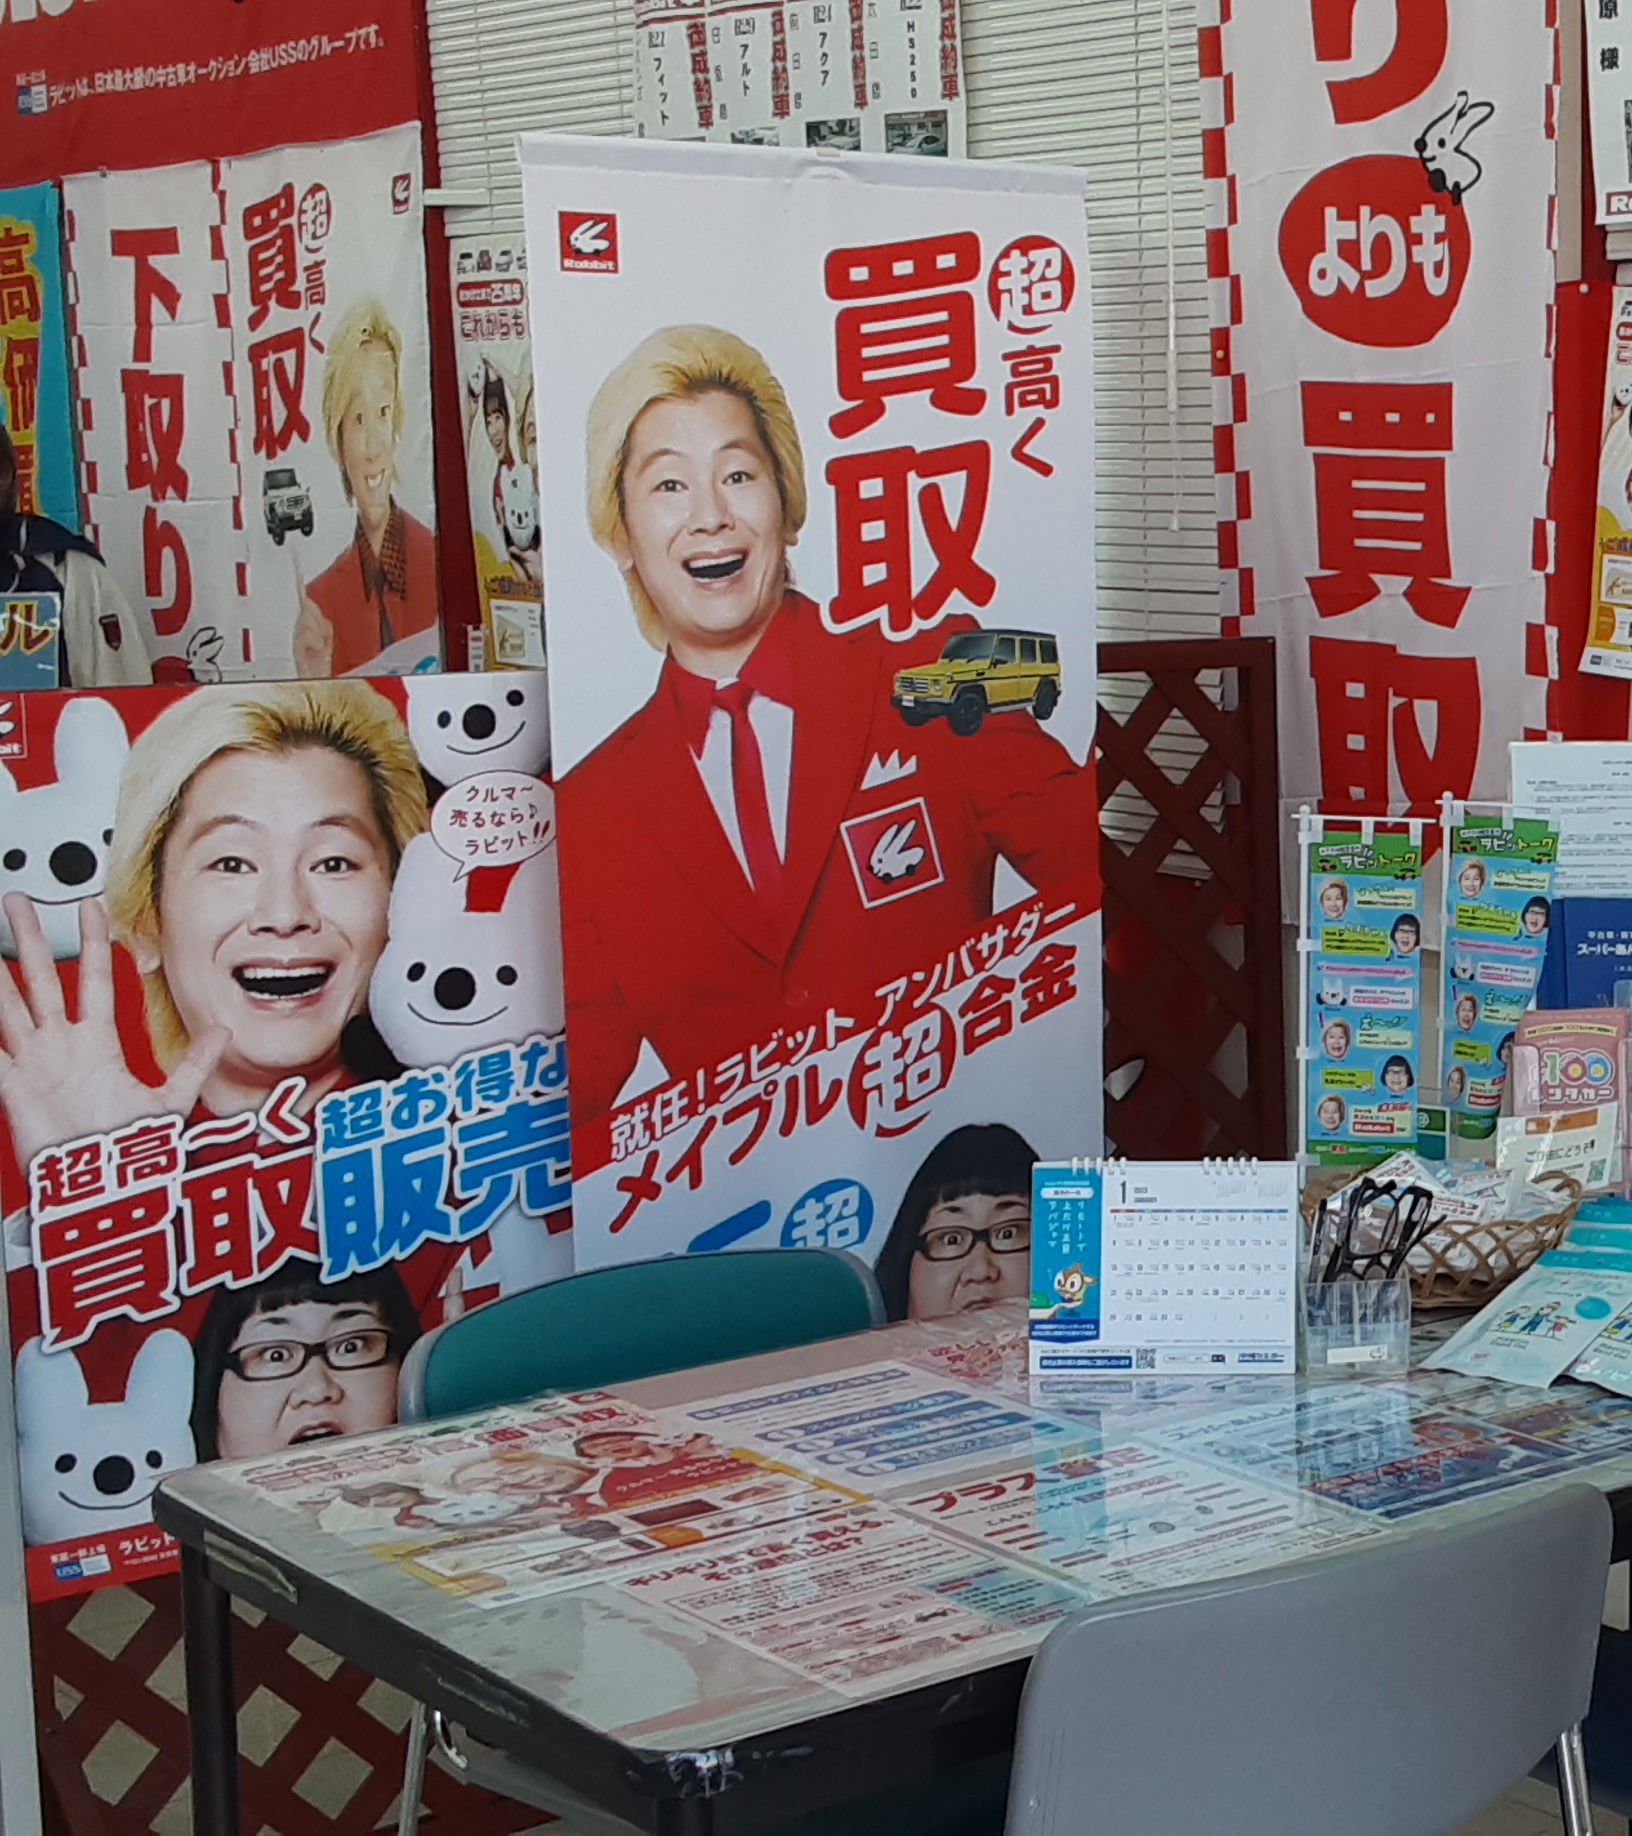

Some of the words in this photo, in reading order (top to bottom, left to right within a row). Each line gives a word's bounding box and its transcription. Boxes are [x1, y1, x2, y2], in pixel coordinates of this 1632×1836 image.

[242, 181, 311, 461] 買取
[299, 182, 332, 355] 超高く
[1307, 204, 1451, 300] よりも
[110, 226, 193, 637] 下取り
[825, 231, 997, 634] 買取
[987, 234, 1077, 478] 超高く
[1300, 379, 1484, 835] 買取
[464, 819, 551, 856] ラビット!!
[320, 1040, 567, 1151] 超お得な
[608, 1004, 856, 1163] 就任!ラビット
[874, 902, 1077, 1024] アンバサダー
[608, 942, 1080, 1234] メイプル超合金
[38, 1153, 318, 1338] 買取
[320, 1095, 573, 1277] 販売
[1120, 1180, 1127, 1204] 1
[118, 1531, 176, 1556] ラビット
